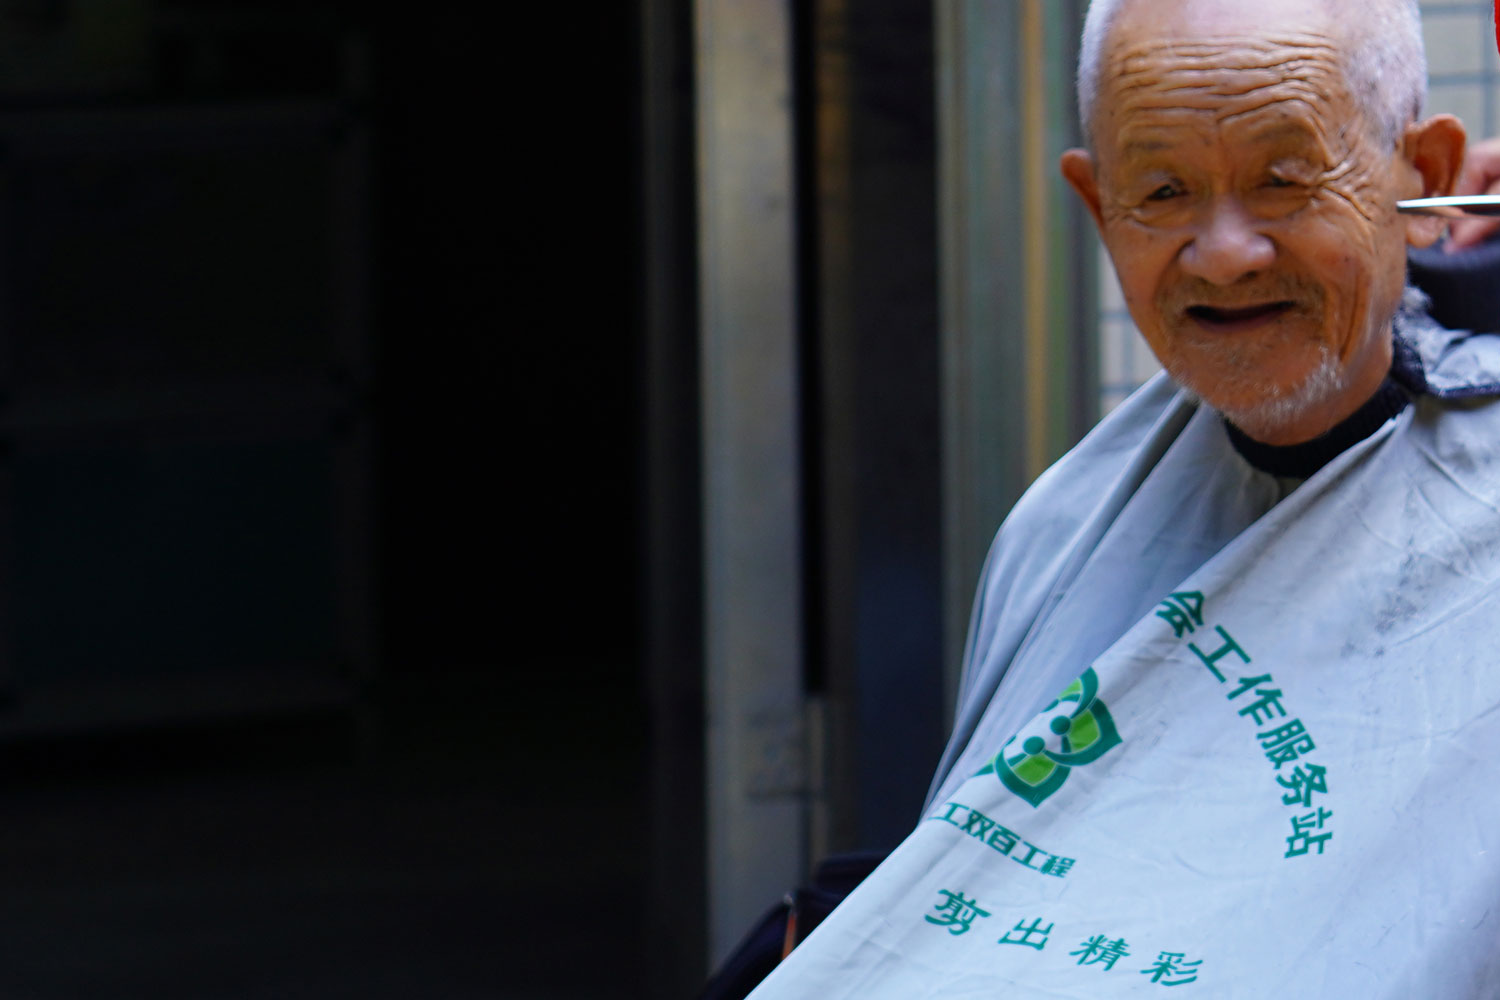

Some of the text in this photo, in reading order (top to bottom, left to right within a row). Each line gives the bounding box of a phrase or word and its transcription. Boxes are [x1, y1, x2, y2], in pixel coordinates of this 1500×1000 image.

[1155, 589, 1334, 859] 会工作服务站
[926, 802, 1077, 879] 工双百工程
[924, 888, 1204, 987] 剪出精彩
